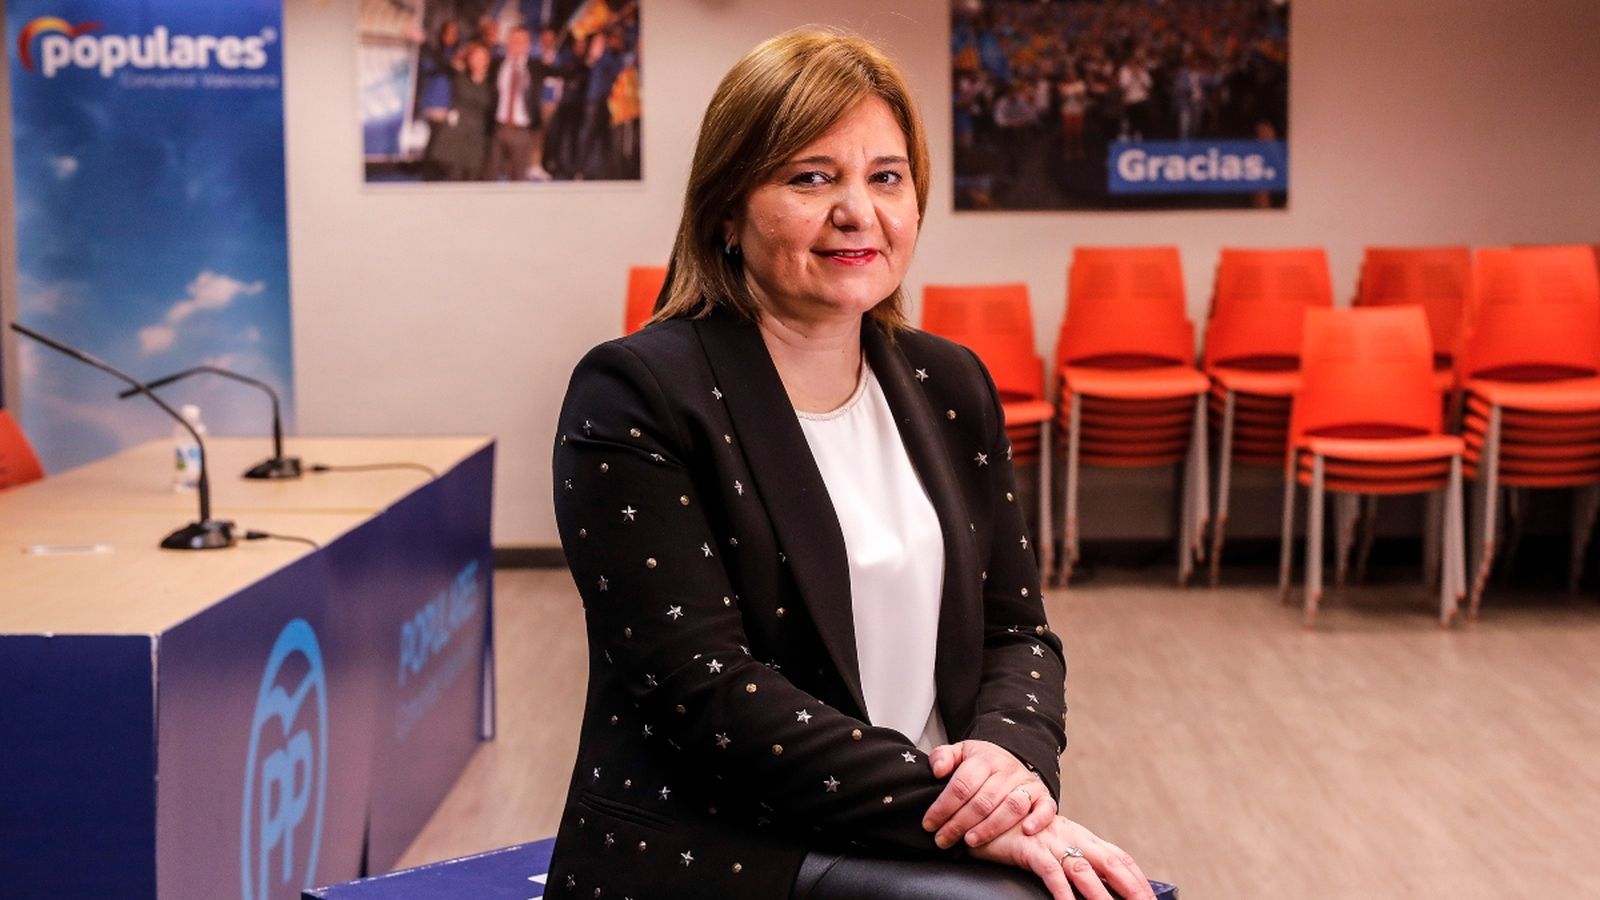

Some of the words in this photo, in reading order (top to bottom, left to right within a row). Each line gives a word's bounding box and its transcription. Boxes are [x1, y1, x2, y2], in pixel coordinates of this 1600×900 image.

[41, 26, 268, 78] populares
[1117, 148, 1276, 182] Gracias.
[258, 729, 313, 900] PP
